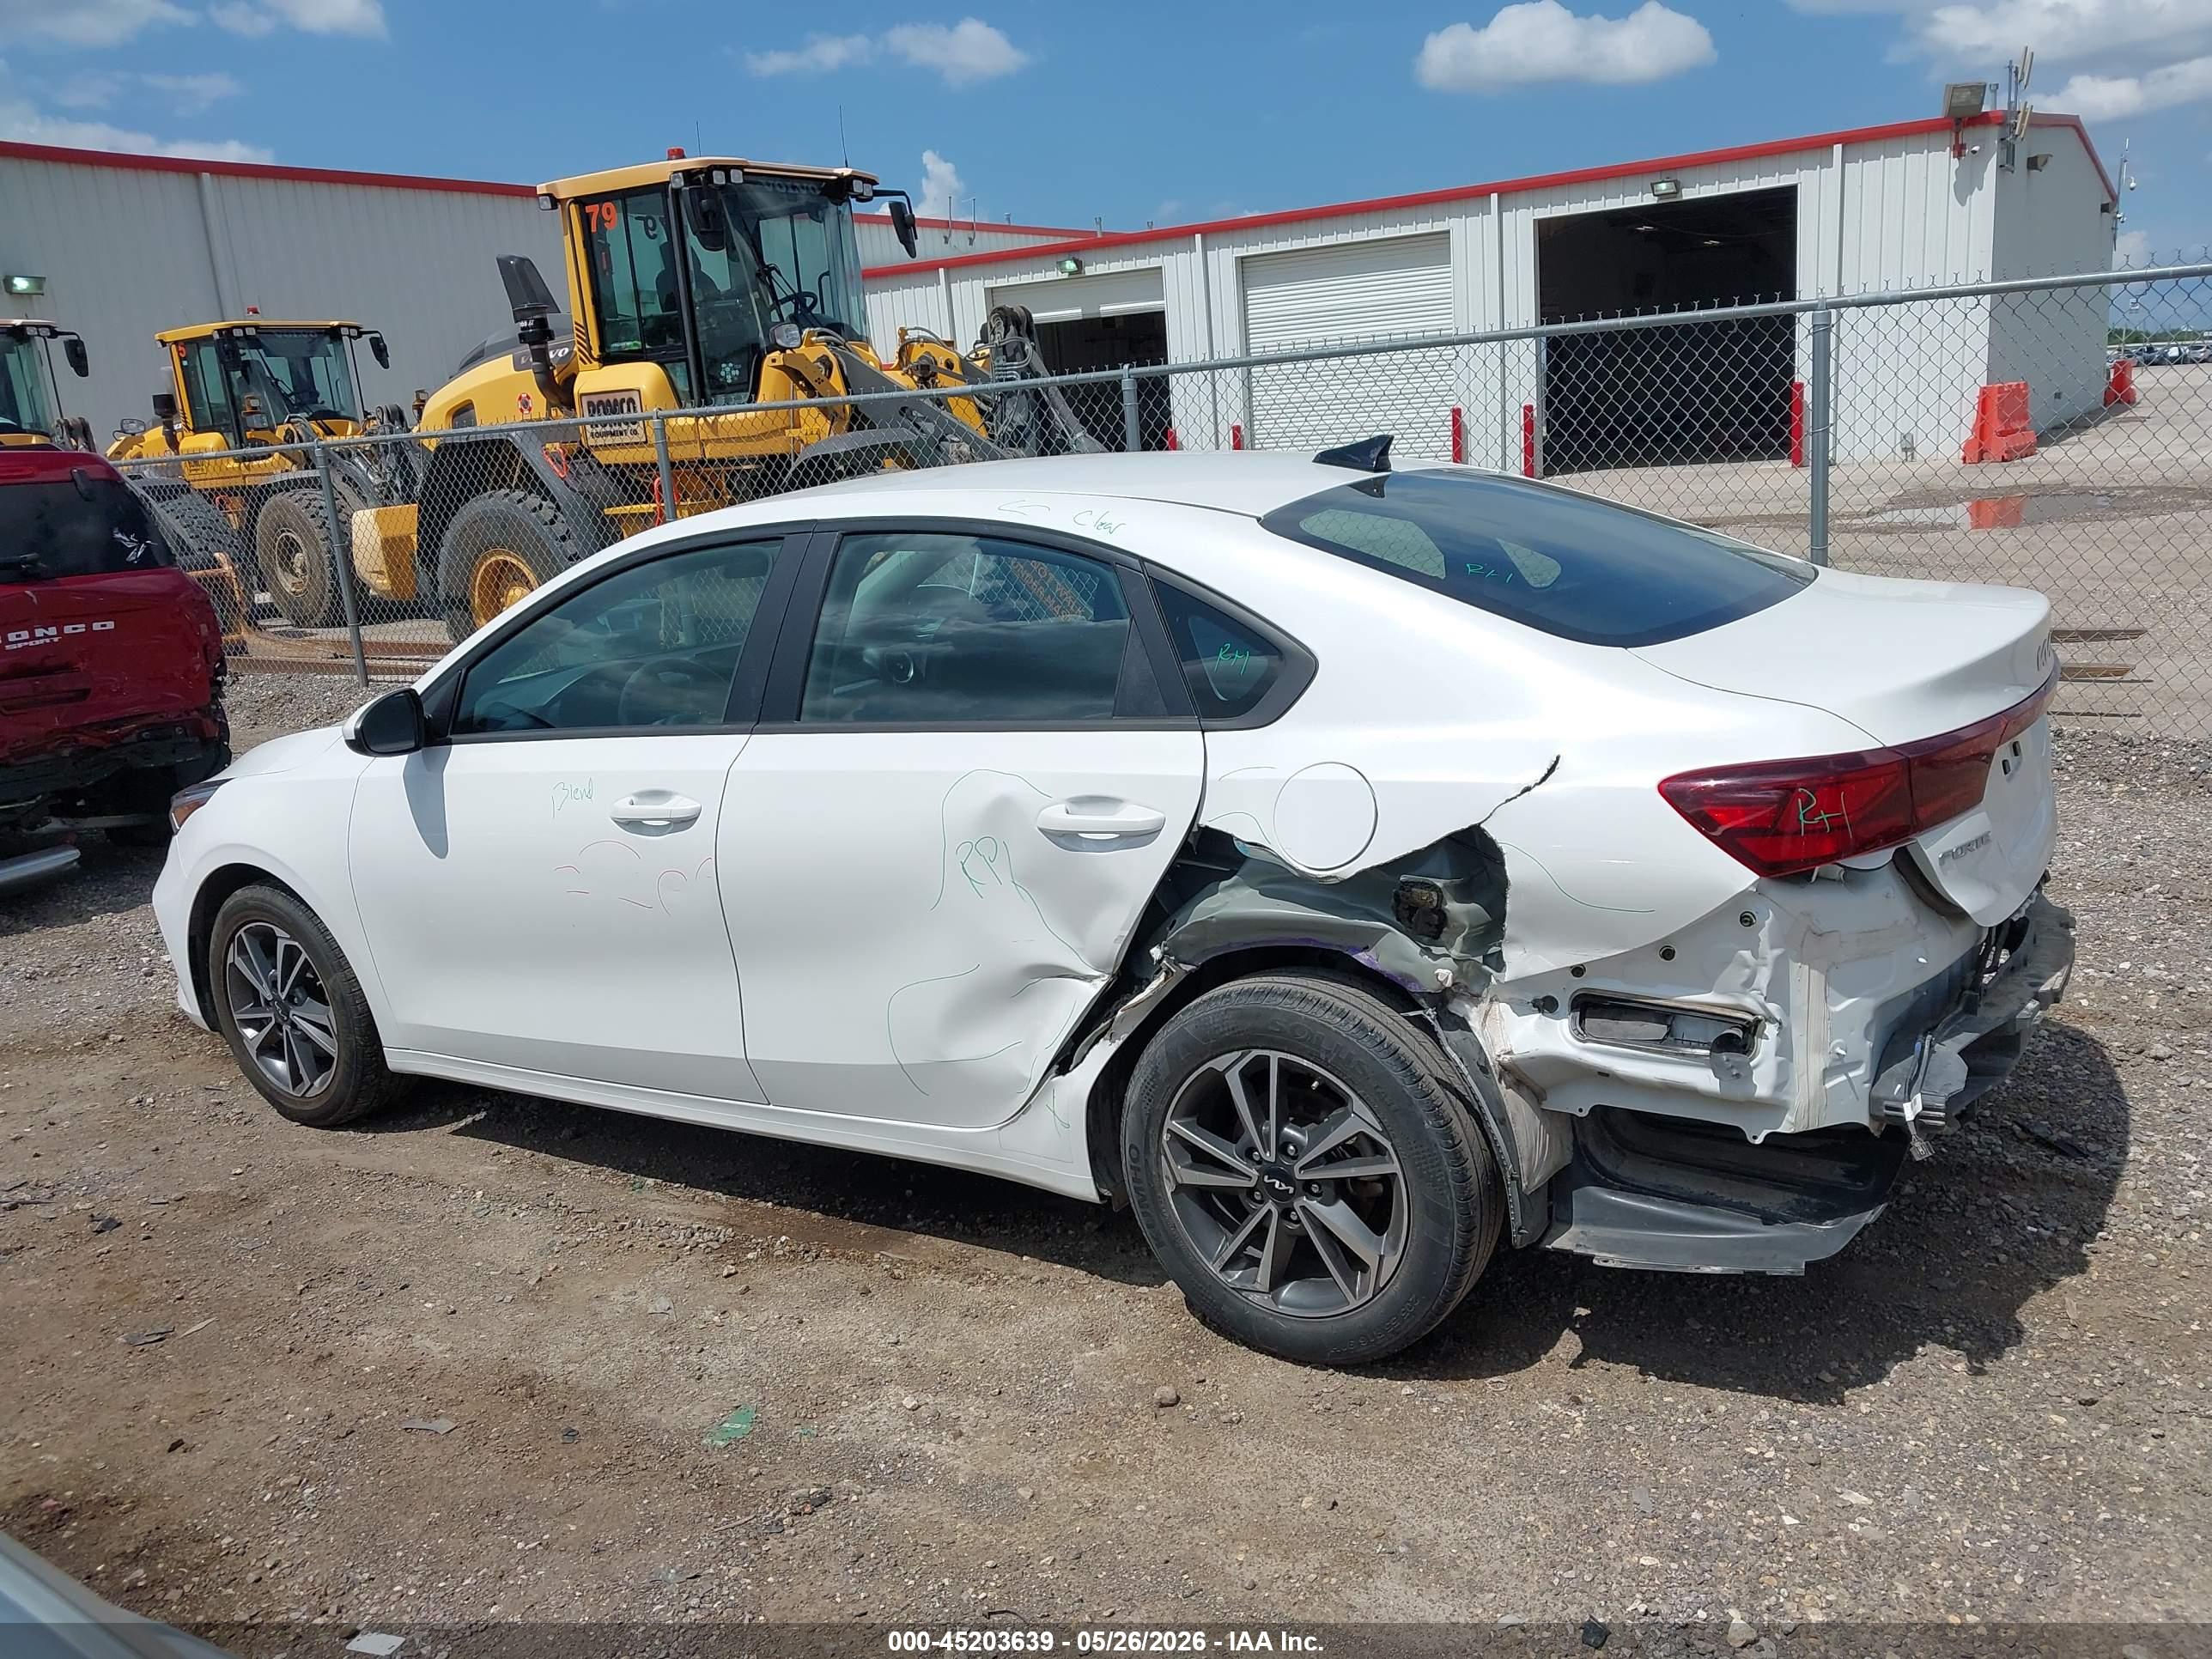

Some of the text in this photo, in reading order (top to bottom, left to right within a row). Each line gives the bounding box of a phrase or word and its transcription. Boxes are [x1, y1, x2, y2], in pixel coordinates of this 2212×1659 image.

[585, 201, 617, 234] 79
[520, 347, 569, 365] VVO
[590, 429, 628, 439] EQUIPMENT
[0, 620, 115, 644] ONCO
[4, 636, 62, 650] SPORT
[551, 776, 593, 818] Blend
[1938, 830, 1992, 866] FORTE
